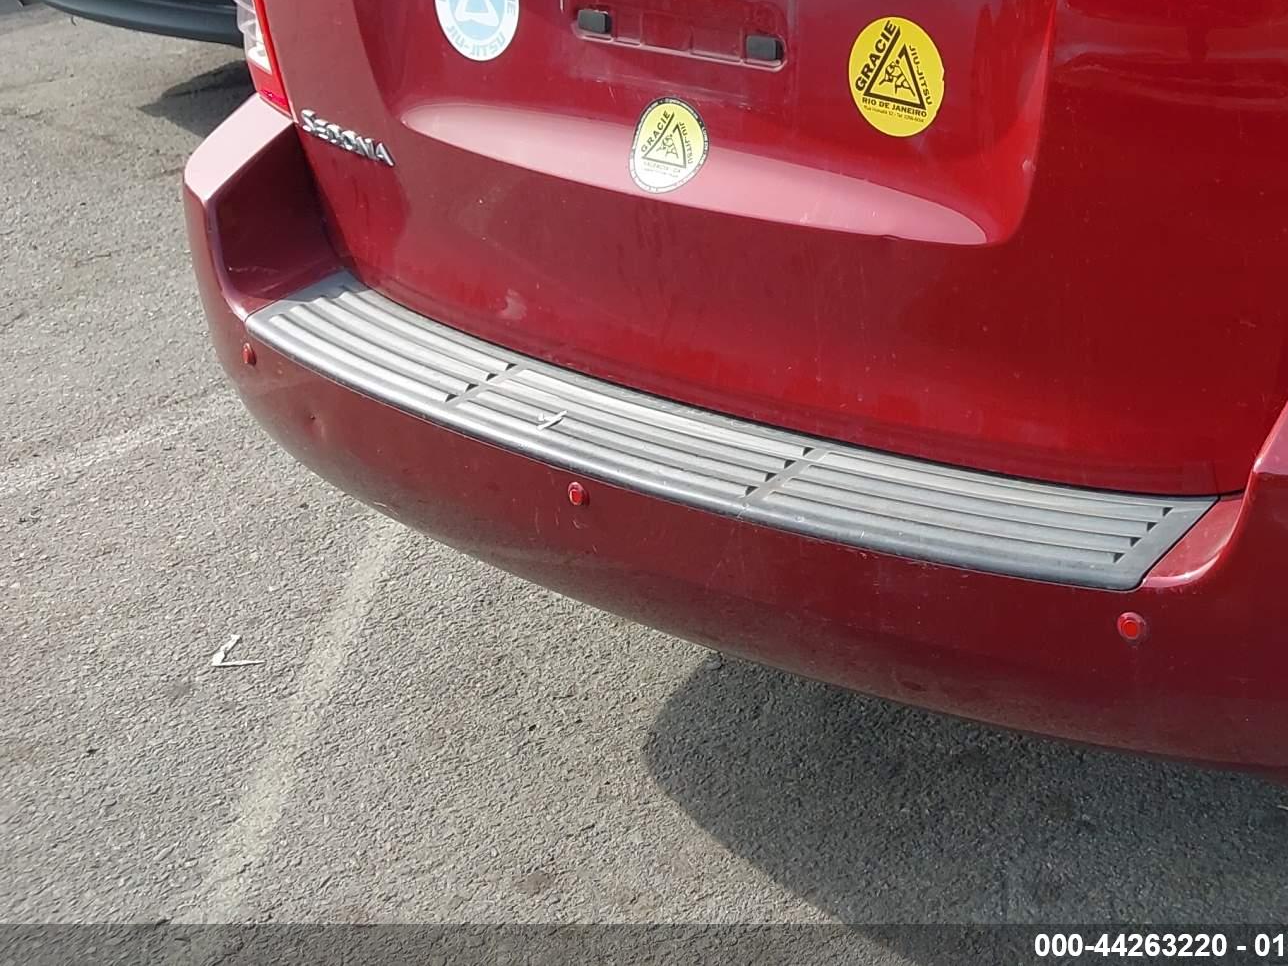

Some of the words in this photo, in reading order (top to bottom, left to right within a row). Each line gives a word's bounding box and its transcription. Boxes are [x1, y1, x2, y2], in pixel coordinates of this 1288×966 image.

[446, 24, 506, 57] JIU-JITSU
[855, 19, 897, 92] GRACIE
[908, 44, 933, 106] JIU-JITSU
[862, 97, 877, 106] RIO
[878, 99, 890, 109] DE
[892, 103, 927, 118] JANEIRO
[301, 109, 395, 167] SEDONA
[640, 109, 671, 153] GRACIE
[678, 120, 694, 165] JIU-JITSU
